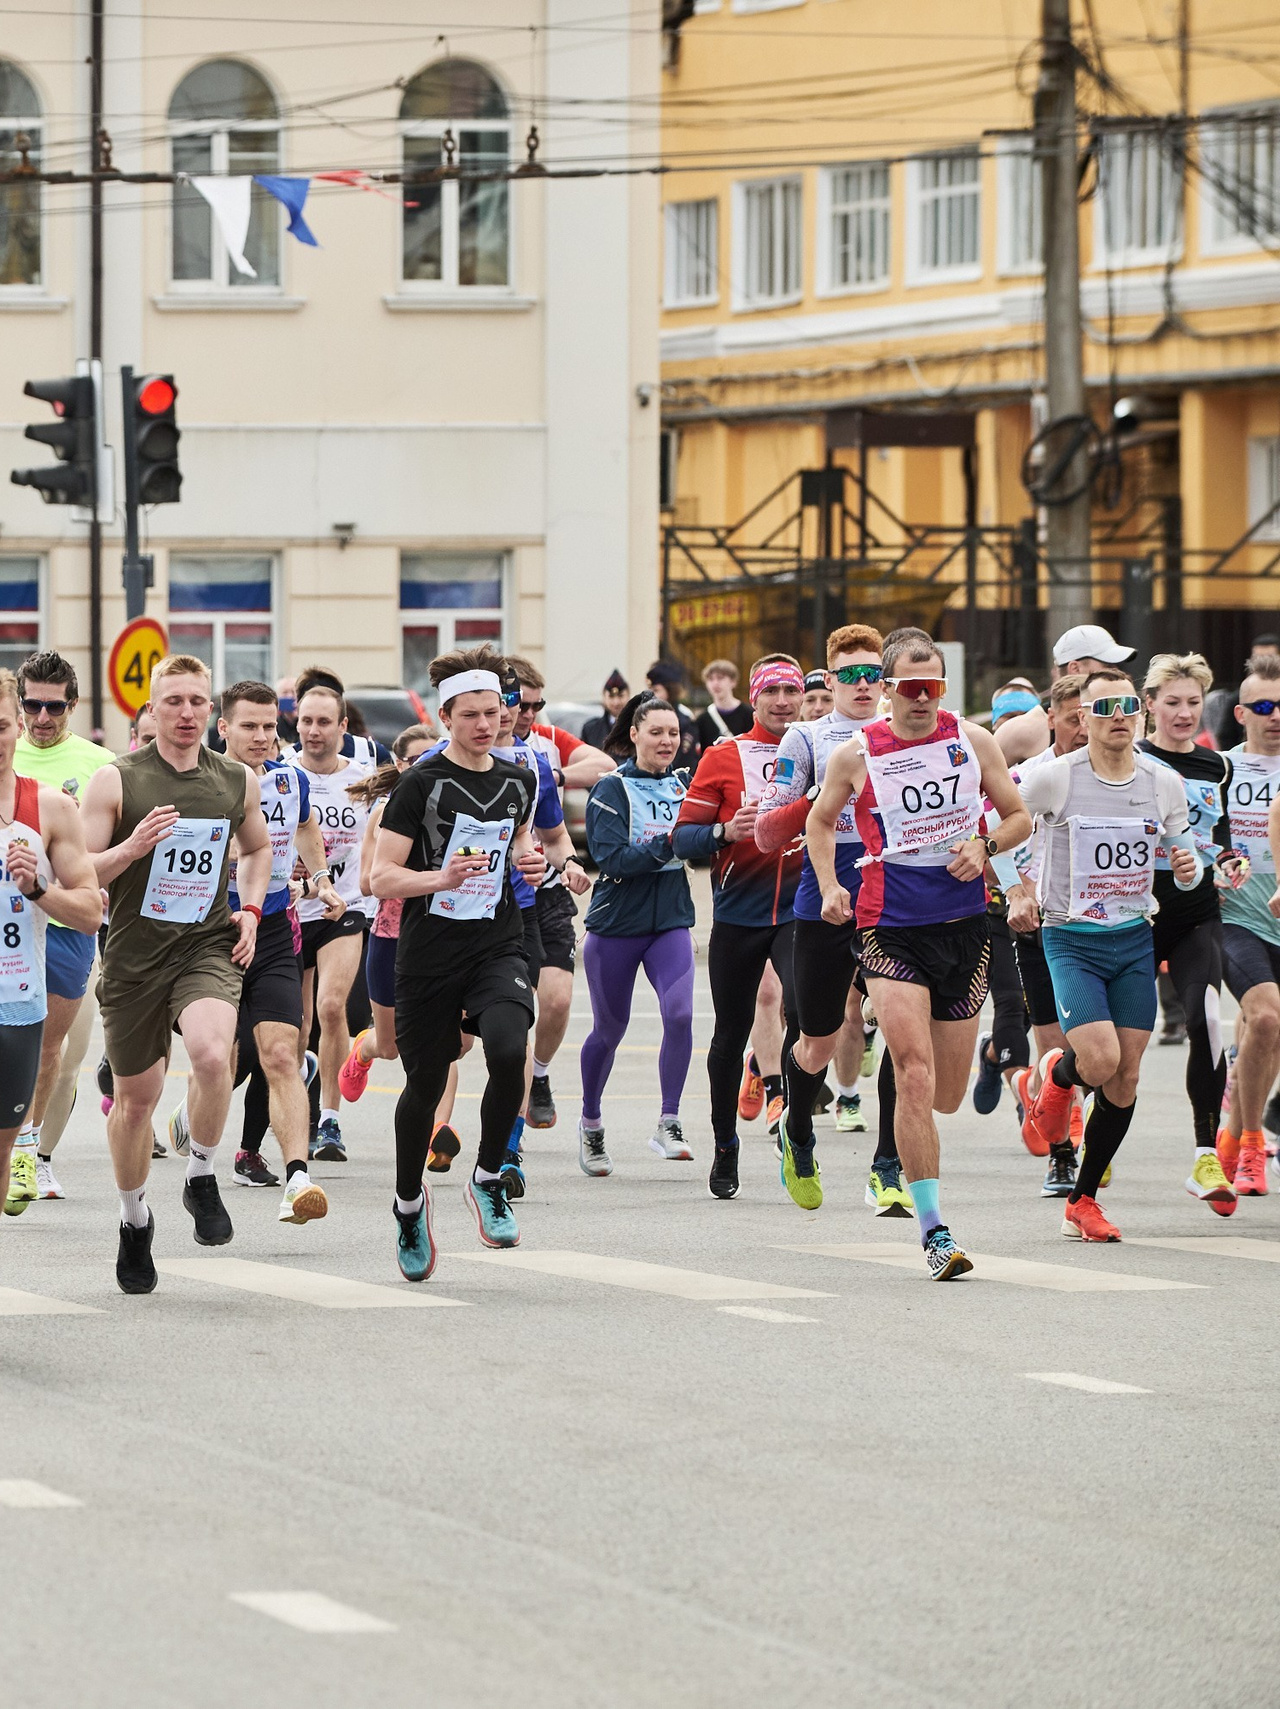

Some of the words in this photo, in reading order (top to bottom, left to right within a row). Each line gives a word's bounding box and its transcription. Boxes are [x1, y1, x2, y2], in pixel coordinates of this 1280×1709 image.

[902, 774, 960, 813] 037
[1236, 781, 1280, 807] 04
[902, 821, 944, 838] КРАСНЫЙ
[164, 848, 213, 875] 198
[1095, 841, 1148, 869] 083
[158, 882, 187, 891] КРАСНЫЙ
[1087, 880, 1127, 889] КРАСНЫЙ
